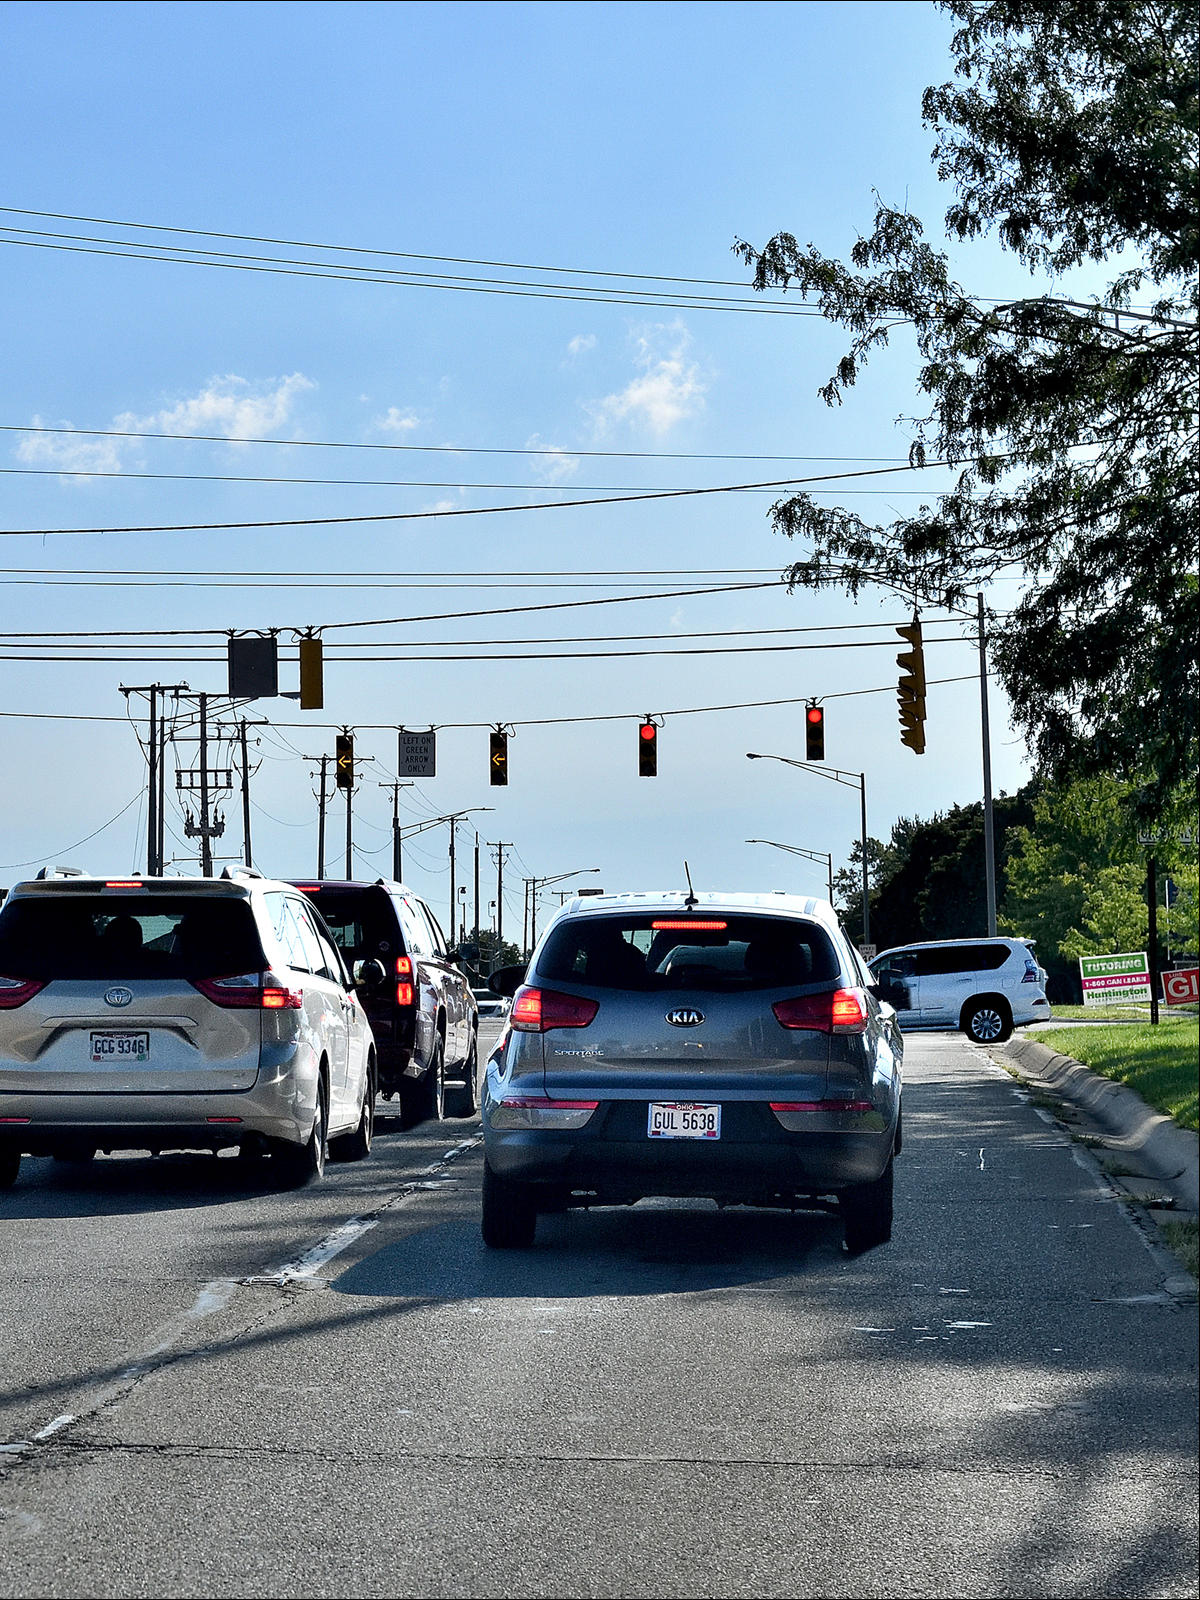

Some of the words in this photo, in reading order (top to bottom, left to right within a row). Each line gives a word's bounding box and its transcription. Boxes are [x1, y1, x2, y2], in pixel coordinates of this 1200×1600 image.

[403, 736, 418, 745] LEFT
[421, 736, 431, 745] ON
[405, 746, 429, 754] GREEN
[405, 755, 429, 763] ARROW
[407, 764, 426, 773] ONLY
[1085, 959, 1142, 972] TUTORING
[1084, 980, 1106, 988] 1-800
[1106, 978, 1122, 986] CAN
[1123, 976, 1147, 984] LEARN
[1086, 987, 1148, 999] Huntington
[672, 1011, 699, 1023] KIA
[94, 1039, 115, 1054] GCG
[117, 1039, 145, 1054] 9346
[654, 1111, 678, 1130] GUL
[682, 1112, 715, 1131] 5638
